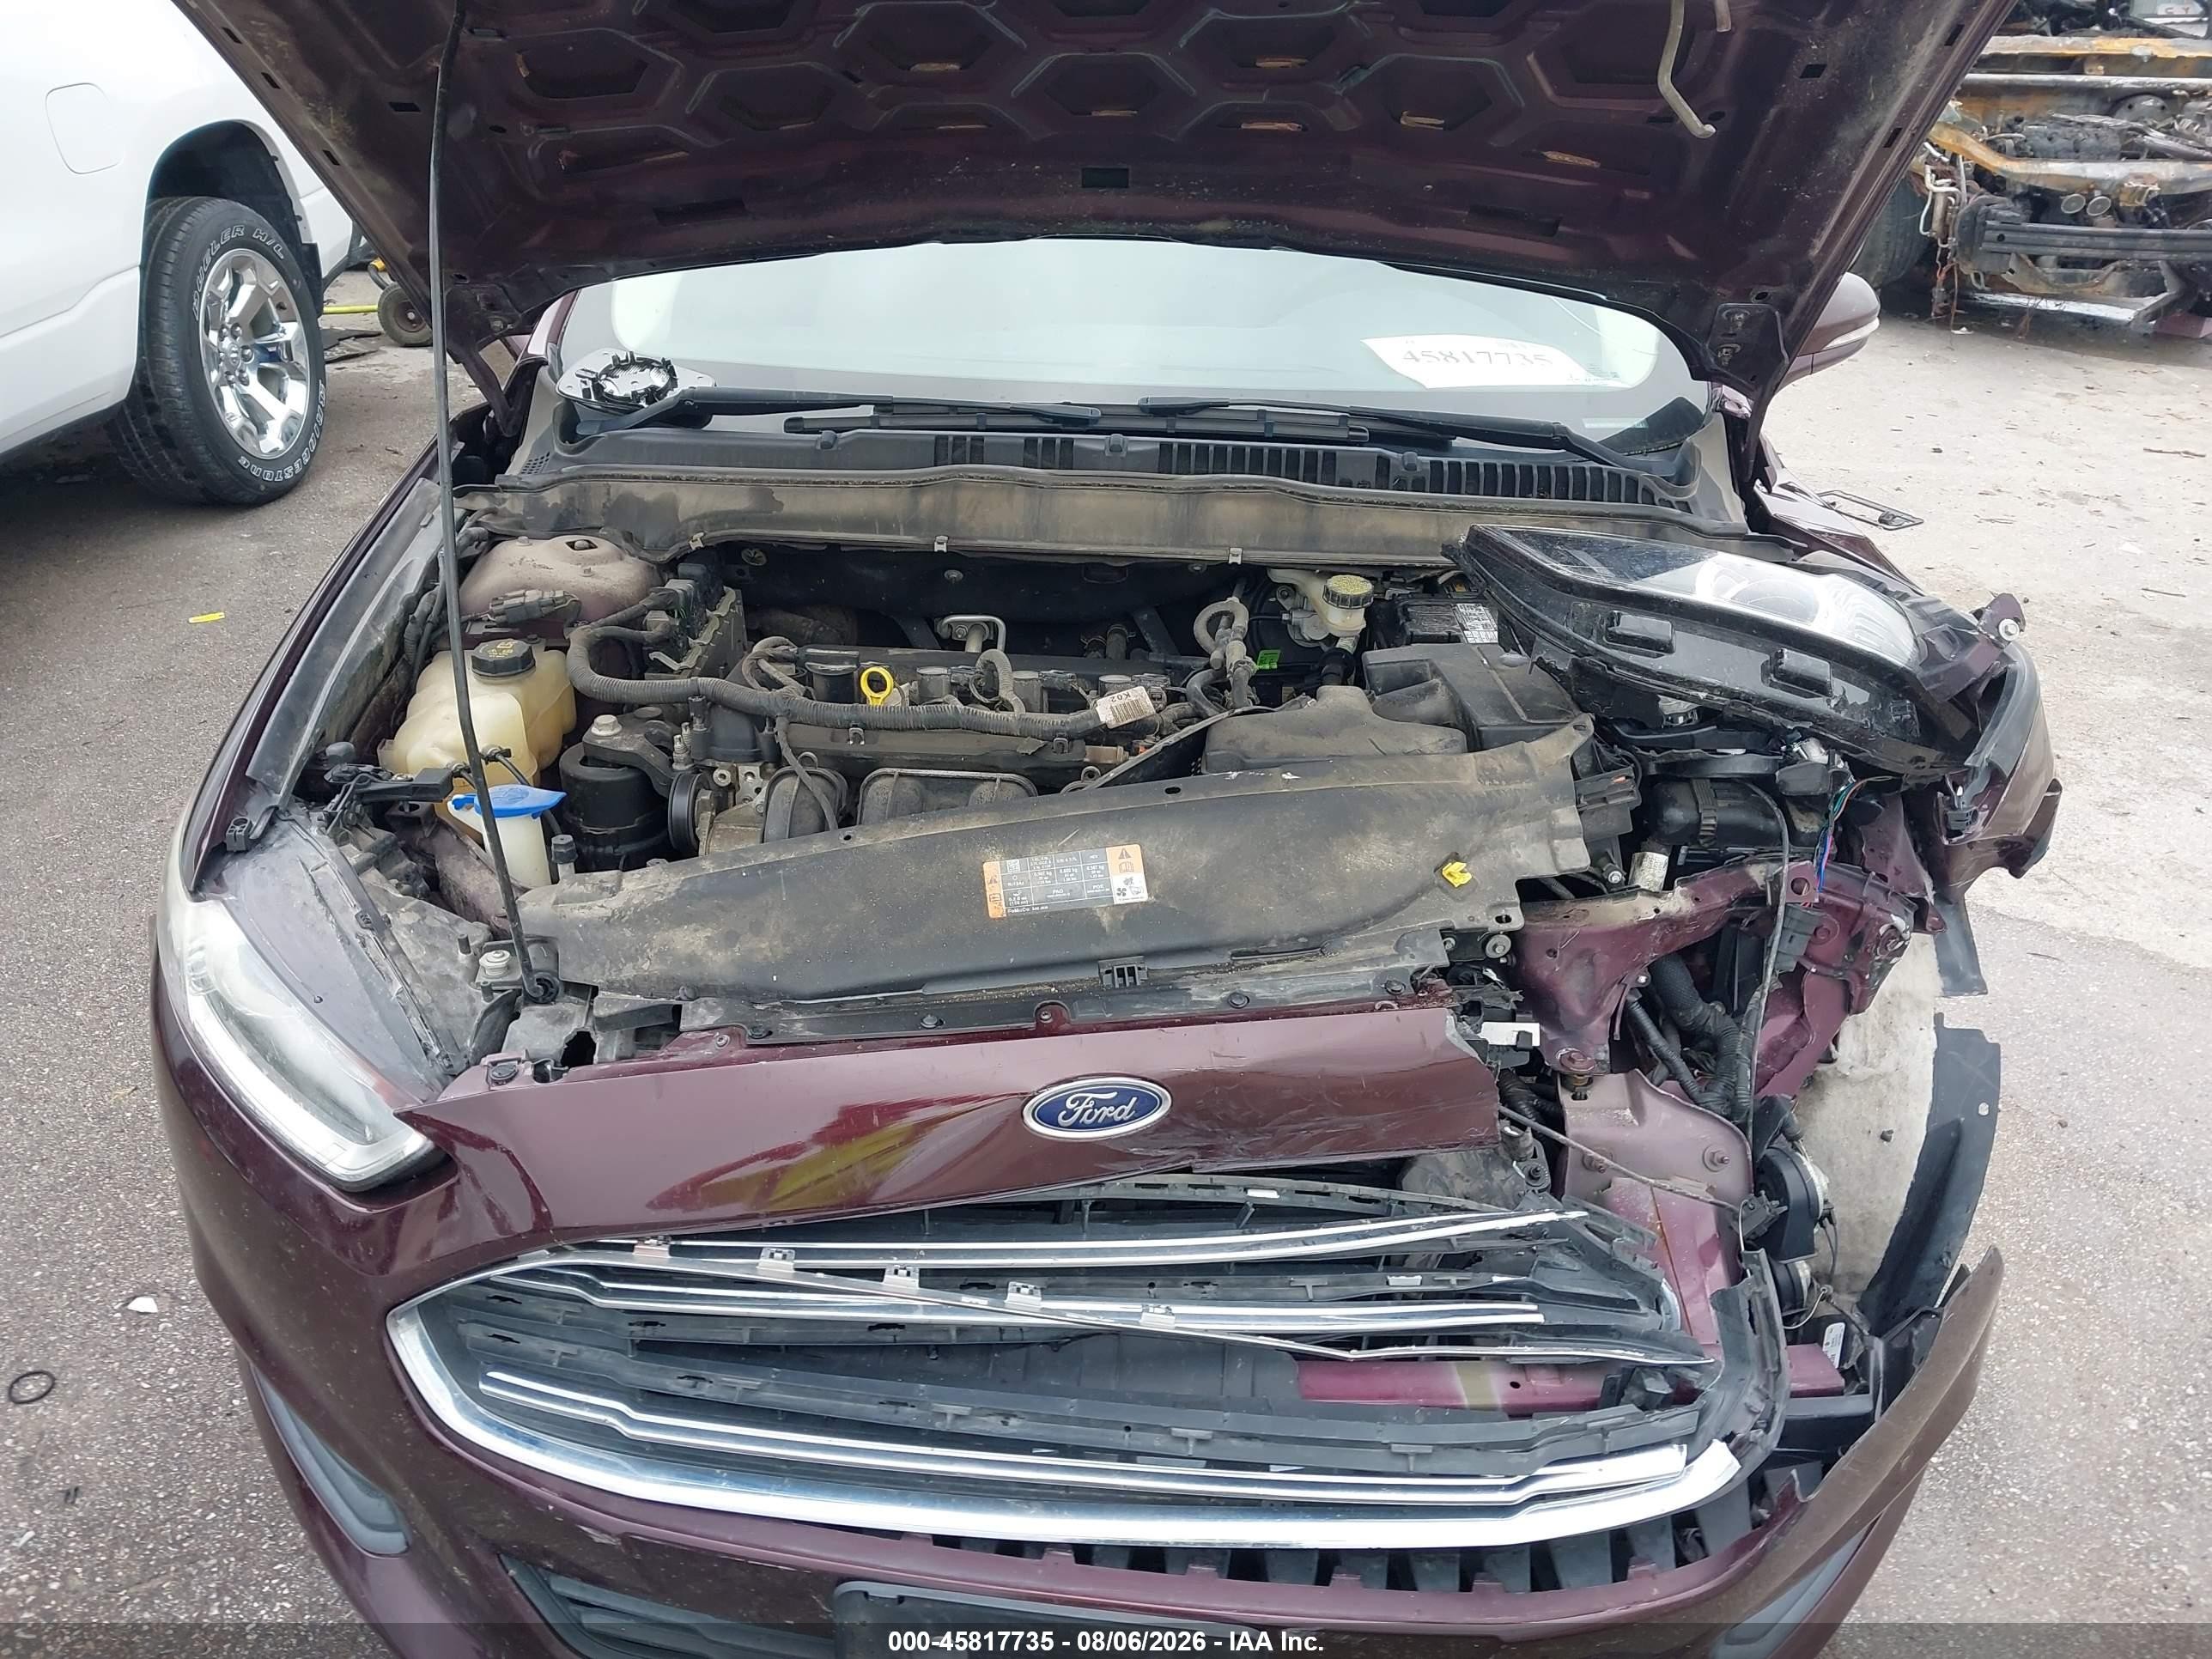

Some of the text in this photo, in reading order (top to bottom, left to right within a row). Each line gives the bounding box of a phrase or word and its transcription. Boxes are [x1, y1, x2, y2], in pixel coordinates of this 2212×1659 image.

[192, 225, 284, 321] DUELER H/L
[1402, 349, 1553, 366] 45817735
[238, 379, 326, 482] BRIDGESTONE
[1057, 1091, 1138, 1127] Ford
